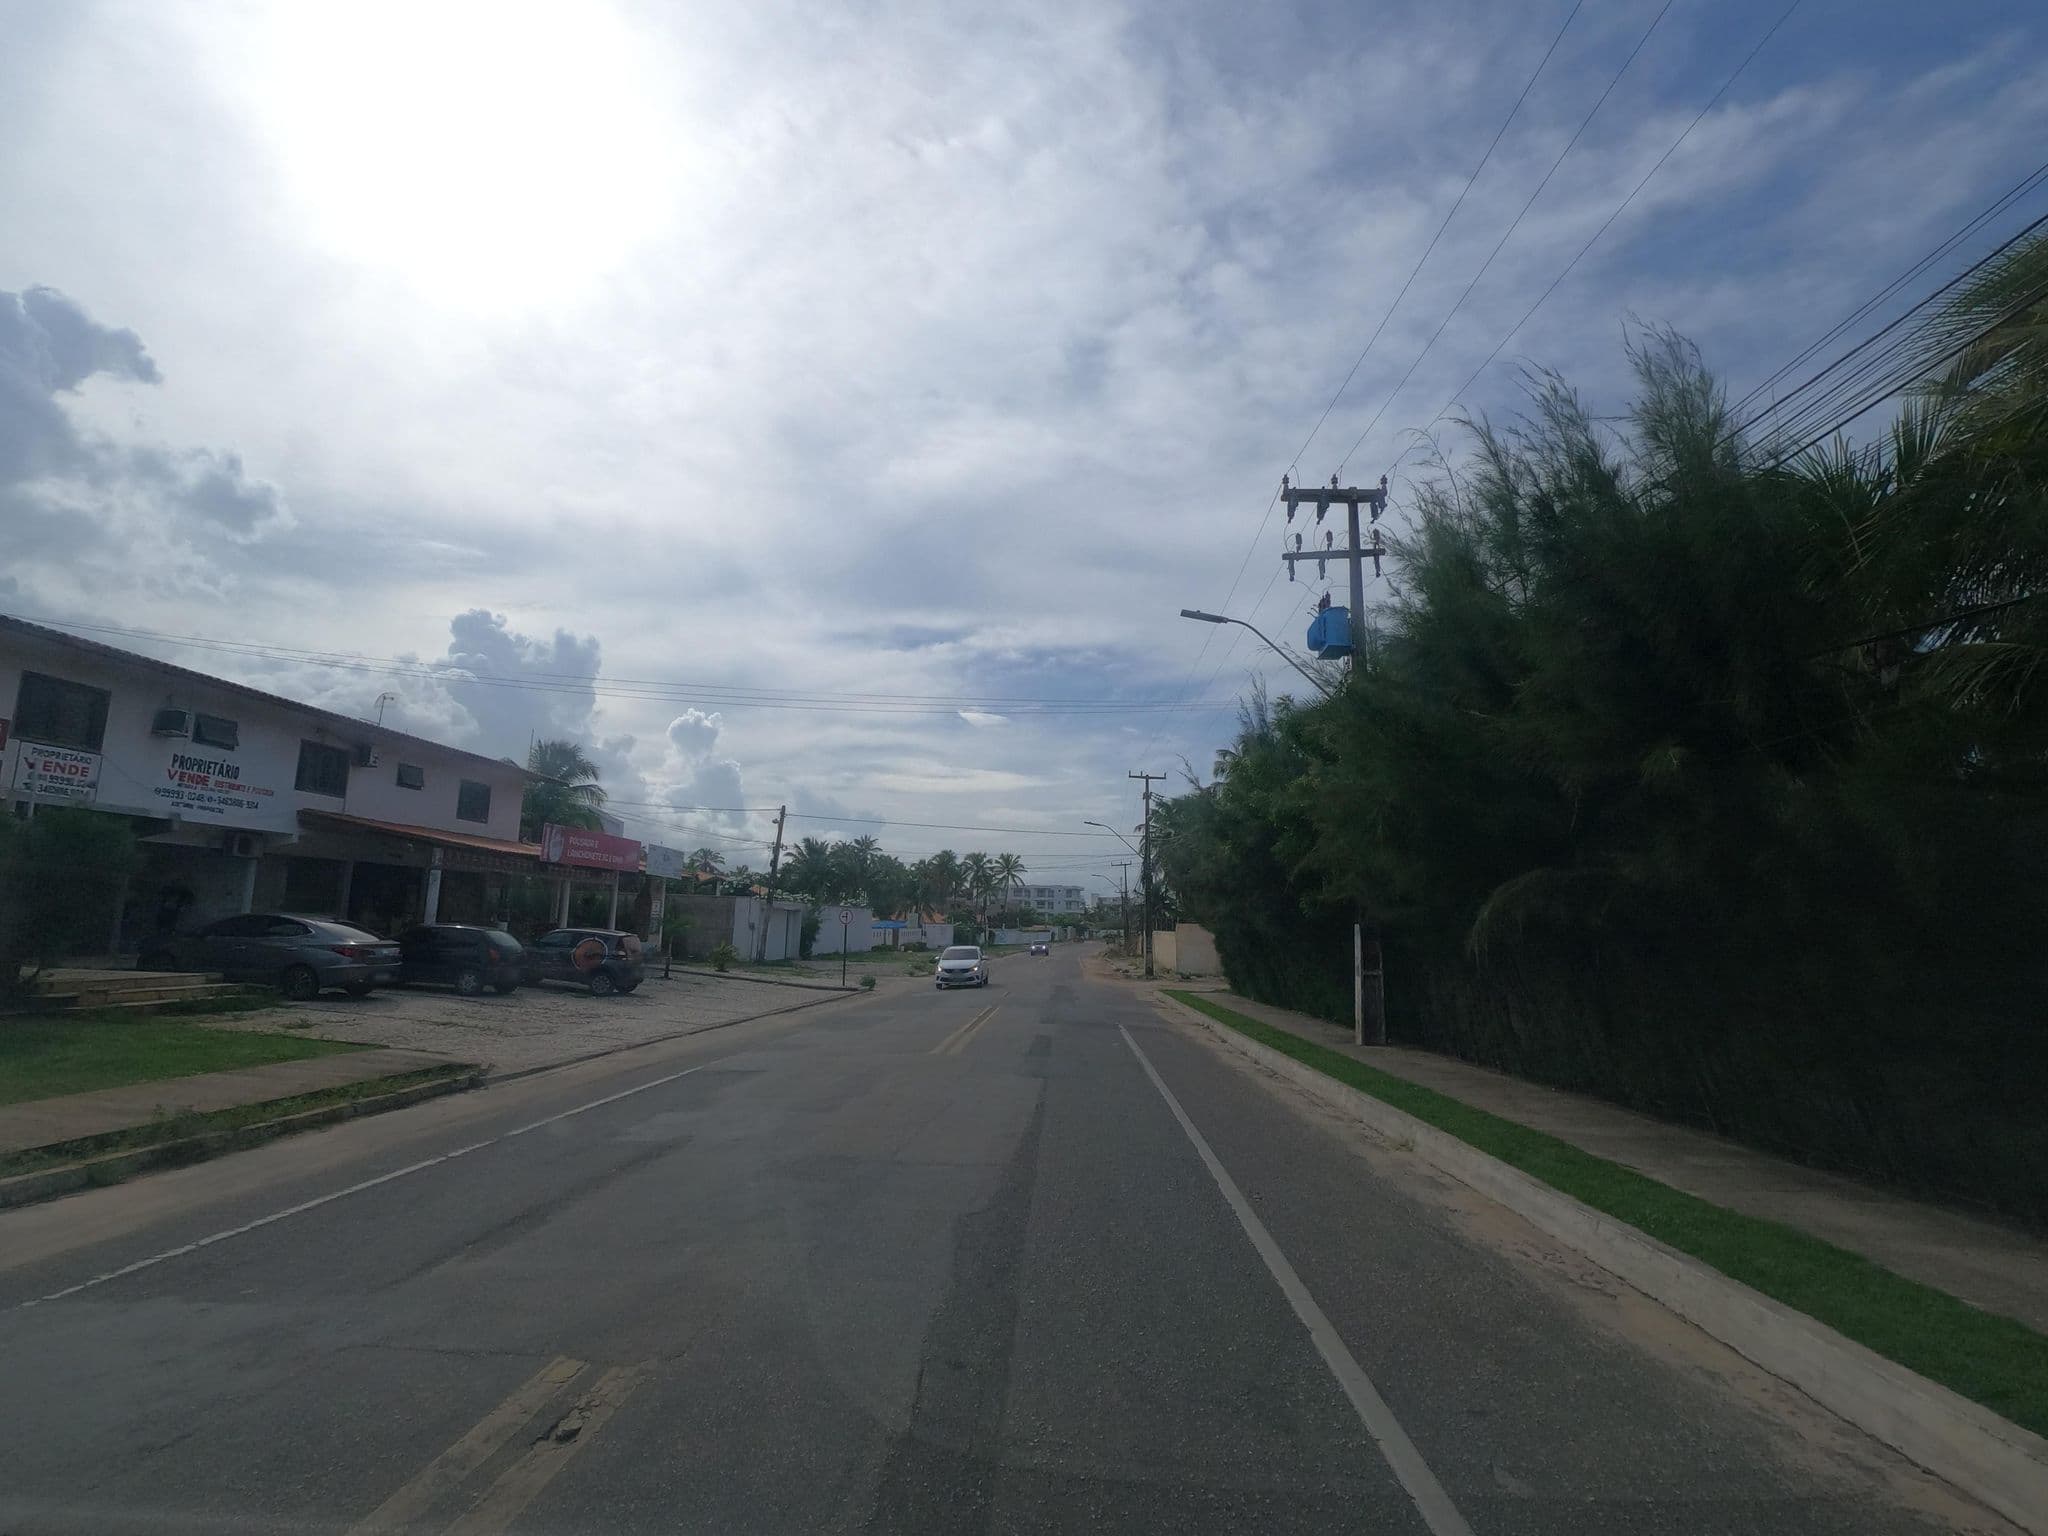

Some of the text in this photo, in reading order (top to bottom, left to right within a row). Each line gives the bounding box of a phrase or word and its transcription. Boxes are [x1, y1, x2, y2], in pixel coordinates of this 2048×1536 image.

[31, 747, 92, 765] PROPRIETÁRIO
[171, 753, 240, 780] PROPRIETÁRIO
[166, 768, 211, 787] VENDE
